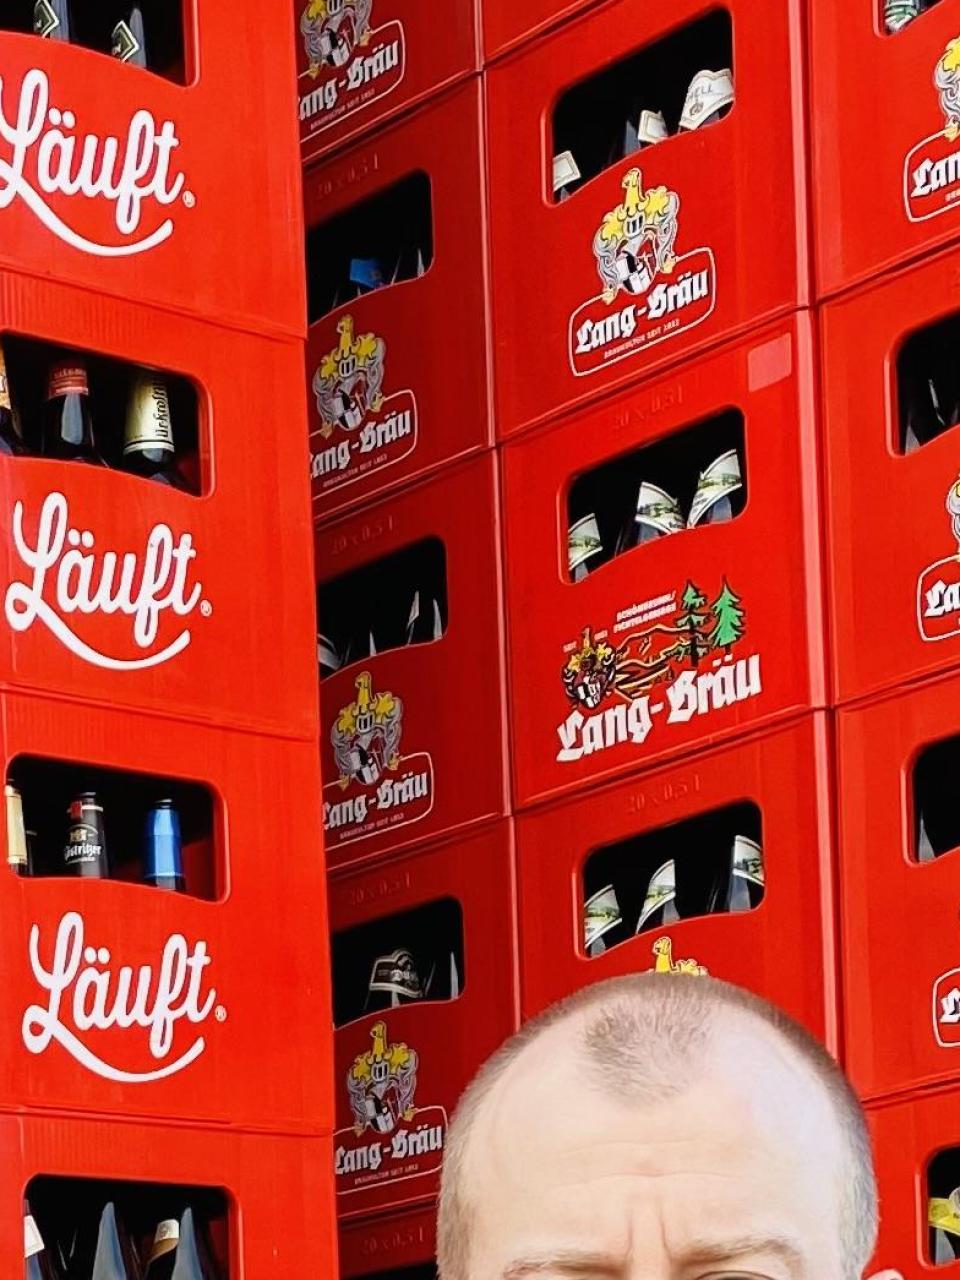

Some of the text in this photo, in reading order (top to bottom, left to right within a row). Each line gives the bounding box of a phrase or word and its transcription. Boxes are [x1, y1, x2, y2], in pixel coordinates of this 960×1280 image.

[298, 39, 399, 121] ang-Bräu
[575, 268, 709, 355] Lang-Bräu
[310, 410, 411, 480] ang-Bräu
[555, 653, 762, 762] Lang-Bräu
